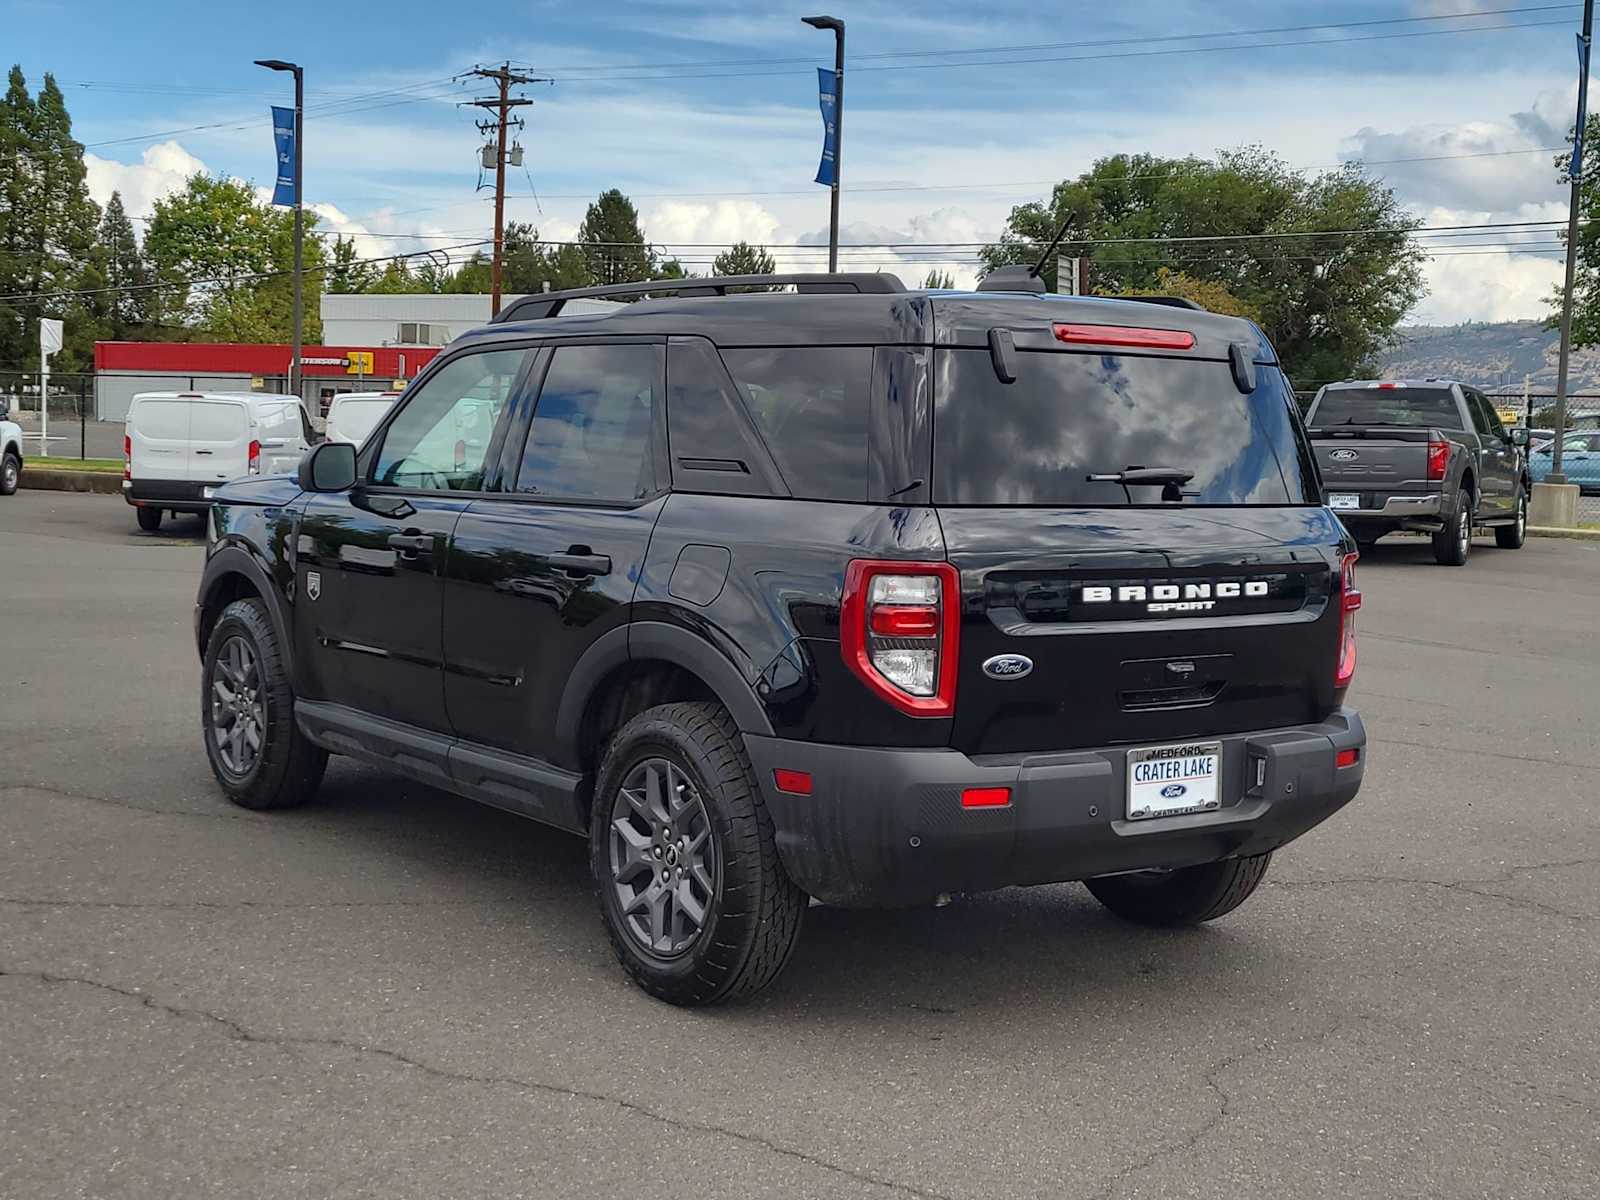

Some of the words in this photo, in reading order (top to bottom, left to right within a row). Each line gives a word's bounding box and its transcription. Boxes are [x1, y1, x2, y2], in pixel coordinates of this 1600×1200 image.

[1082, 581, 1268, 602] BRONCO
[1147, 601, 1216, 612] SPORT
[995, 659, 1024, 673] Ford
[1151, 746, 1200, 760] MEDFORD
[1135, 760, 1180, 782] CRATER
[1184, 757, 1213, 777] LAKE
[1164, 785, 1184, 797] Ford
